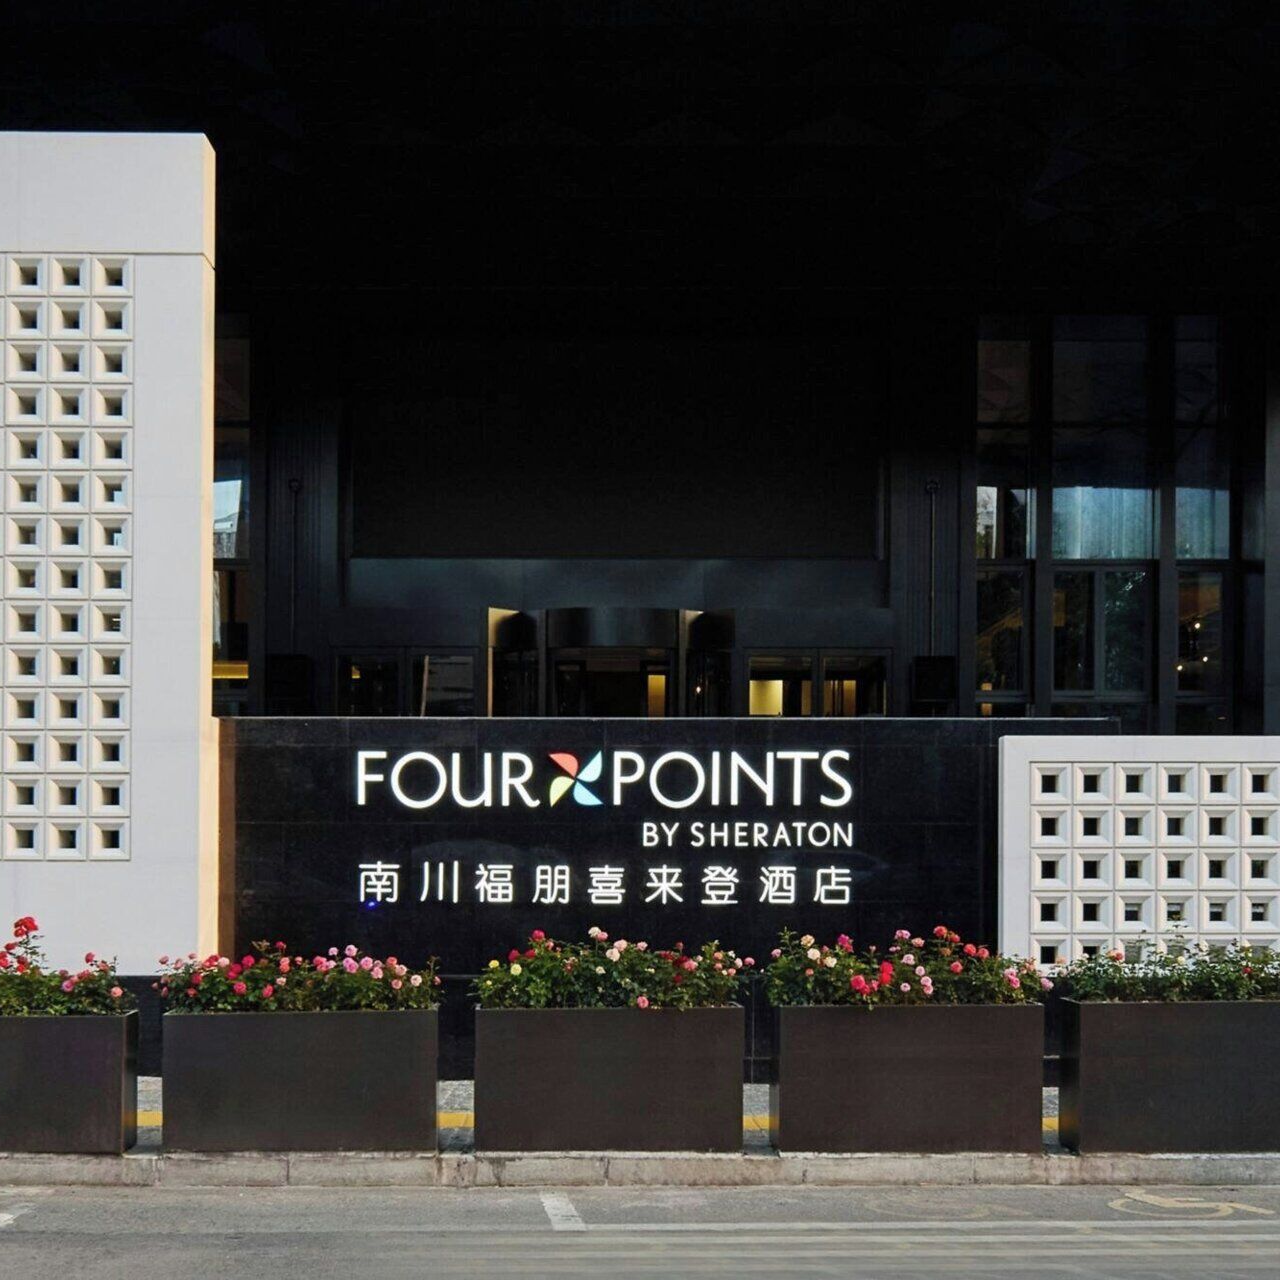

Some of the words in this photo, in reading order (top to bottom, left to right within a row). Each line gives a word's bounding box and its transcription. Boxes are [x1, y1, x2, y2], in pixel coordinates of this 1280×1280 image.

[356, 750, 541, 809] FOUR
[612, 749, 853, 809] POINTS
[642, 822, 680, 848] BY
[690, 821, 853, 848] SHERATON
[357, 860, 852, 906] 南川福朋喜来登酒店
